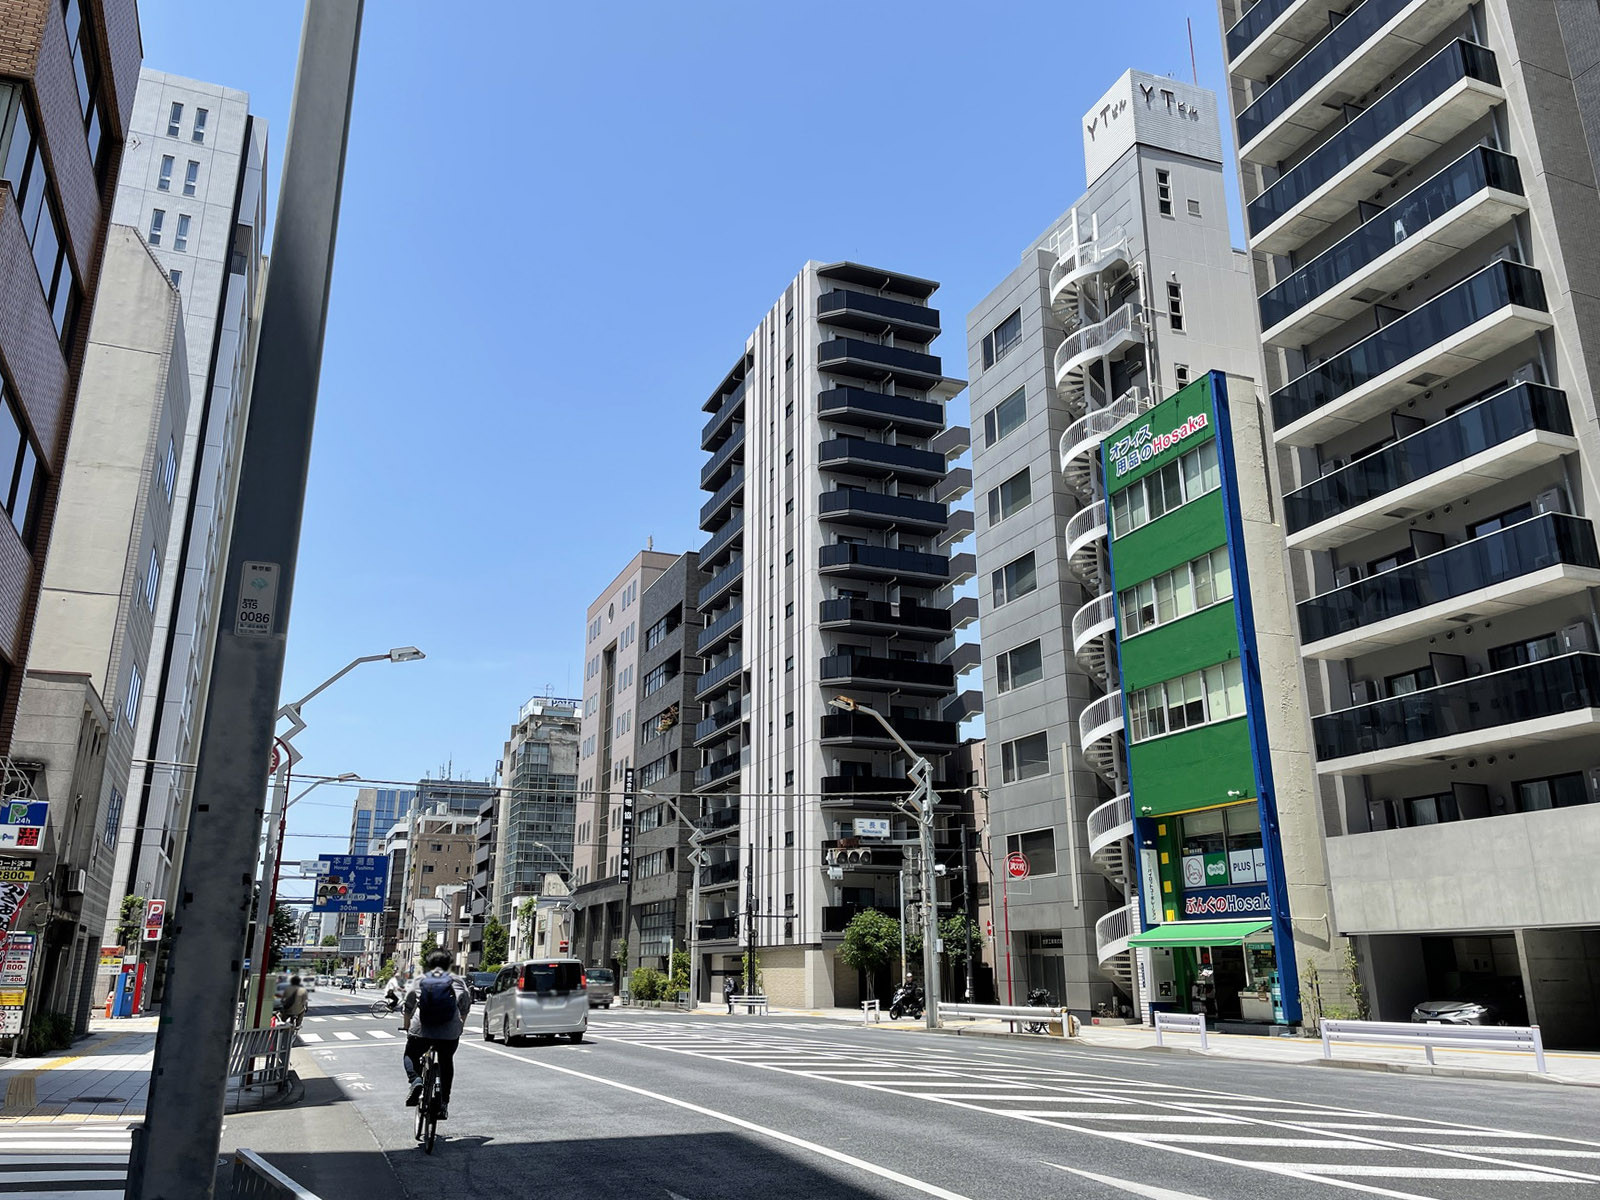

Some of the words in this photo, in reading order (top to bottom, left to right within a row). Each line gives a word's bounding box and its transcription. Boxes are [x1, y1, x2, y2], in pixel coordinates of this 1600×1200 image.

[1109, 424, 1153, 462] オフィス
[241, 612, 270, 623] 0086
[17, 828, 40, 846] 満
[1233, 861, 1252, 872] PLUS
[148, 904, 162, 919] P
